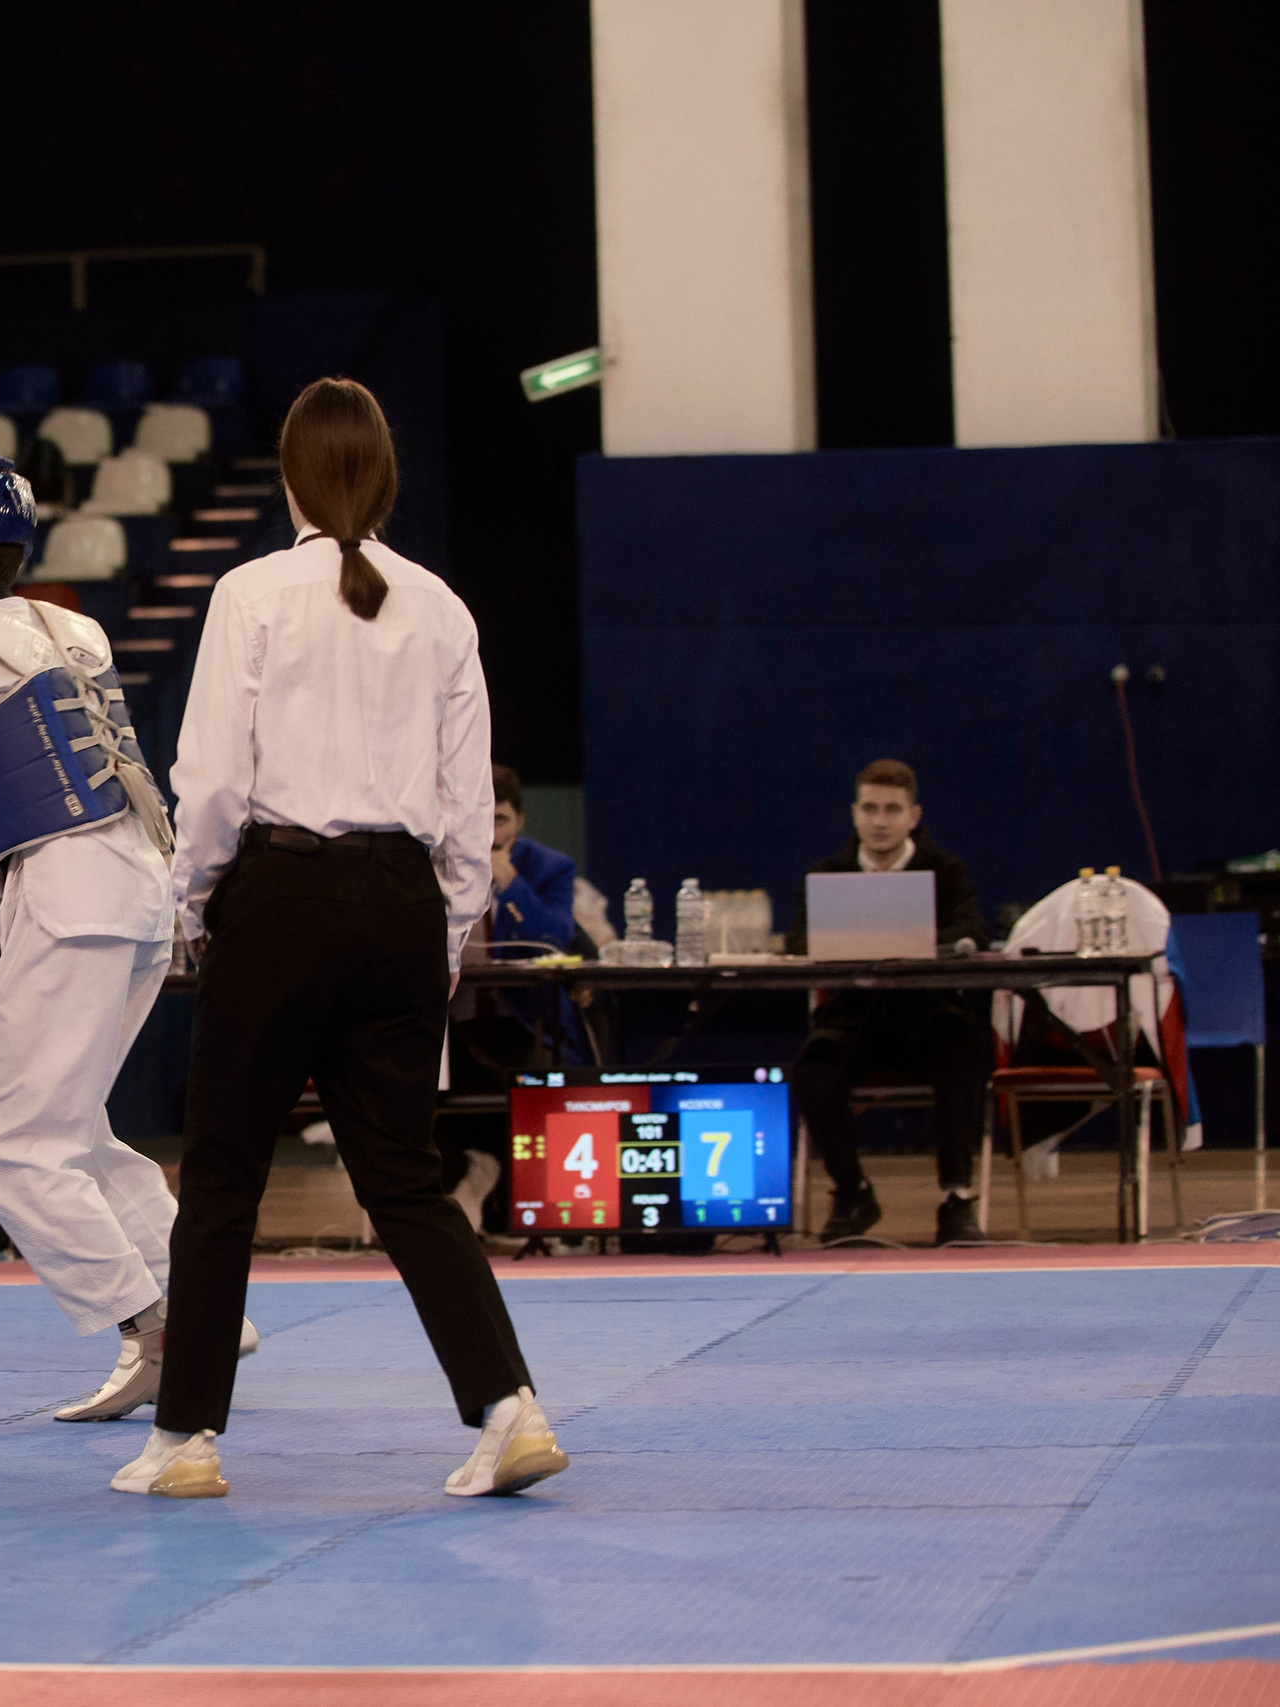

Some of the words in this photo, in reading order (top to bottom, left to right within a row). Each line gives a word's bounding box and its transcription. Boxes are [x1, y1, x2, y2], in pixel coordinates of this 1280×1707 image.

[26, 697, 43, 723] System
[37, 724, 53, 750] Scoring
[631, 1113, 668, 1124] MATCH
[637, 1125, 663, 1139] 101
[564, 1133, 598, 1179] 4
[621, 1148, 676, 1173] 0:41
[701, 1132, 732, 1177] 7
[632, 1194, 669, 1205] ROUND
[522, 1210, 536, 1225] 0
[560, 1210, 570, 1224] 1
[593, 1209, 605, 1224] 2
[642, 1206, 659, 1227] 3
[696, 1209, 706, 1222] 1
[731, 1208, 741, 1222] 1
[766, 1208, 776, 1221] 1
